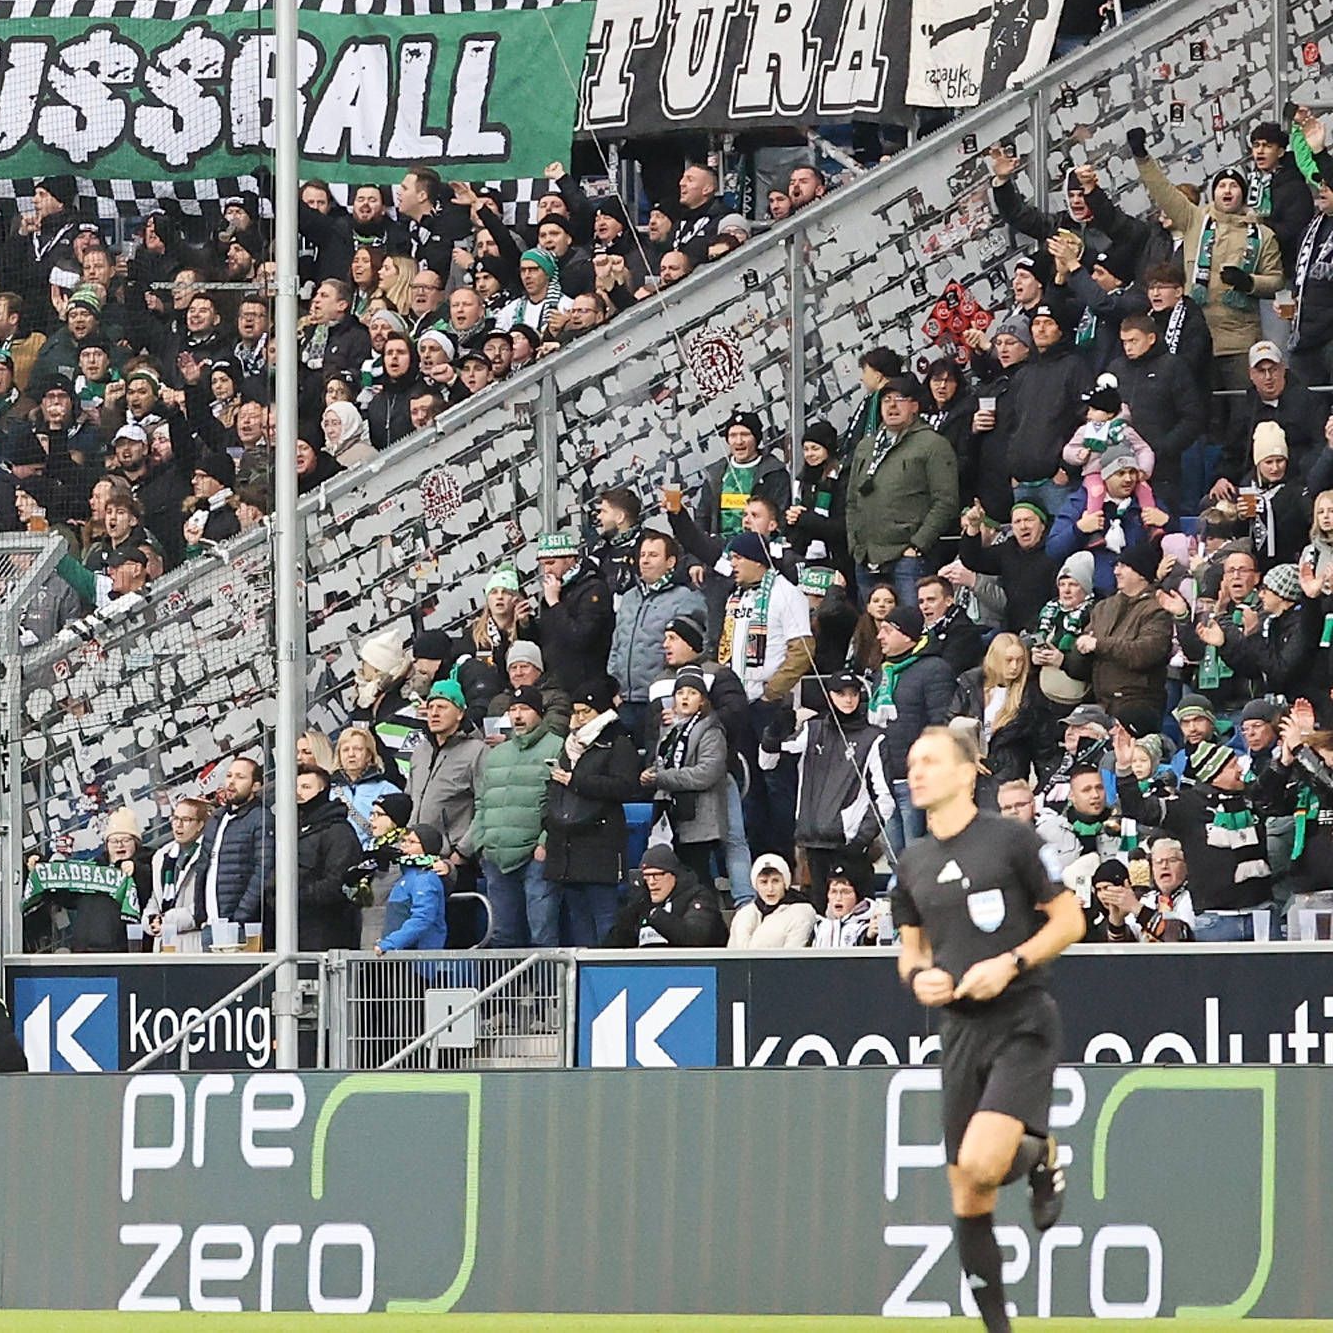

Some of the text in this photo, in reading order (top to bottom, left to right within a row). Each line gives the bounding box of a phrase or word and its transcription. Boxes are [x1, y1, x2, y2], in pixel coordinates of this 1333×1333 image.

[129, 992, 271, 1069] koenig
[121, 1072, 307, 1204] pre
[117, 1222, 377, 1314] zero
[881, 1224, 1164, 1319] zero
